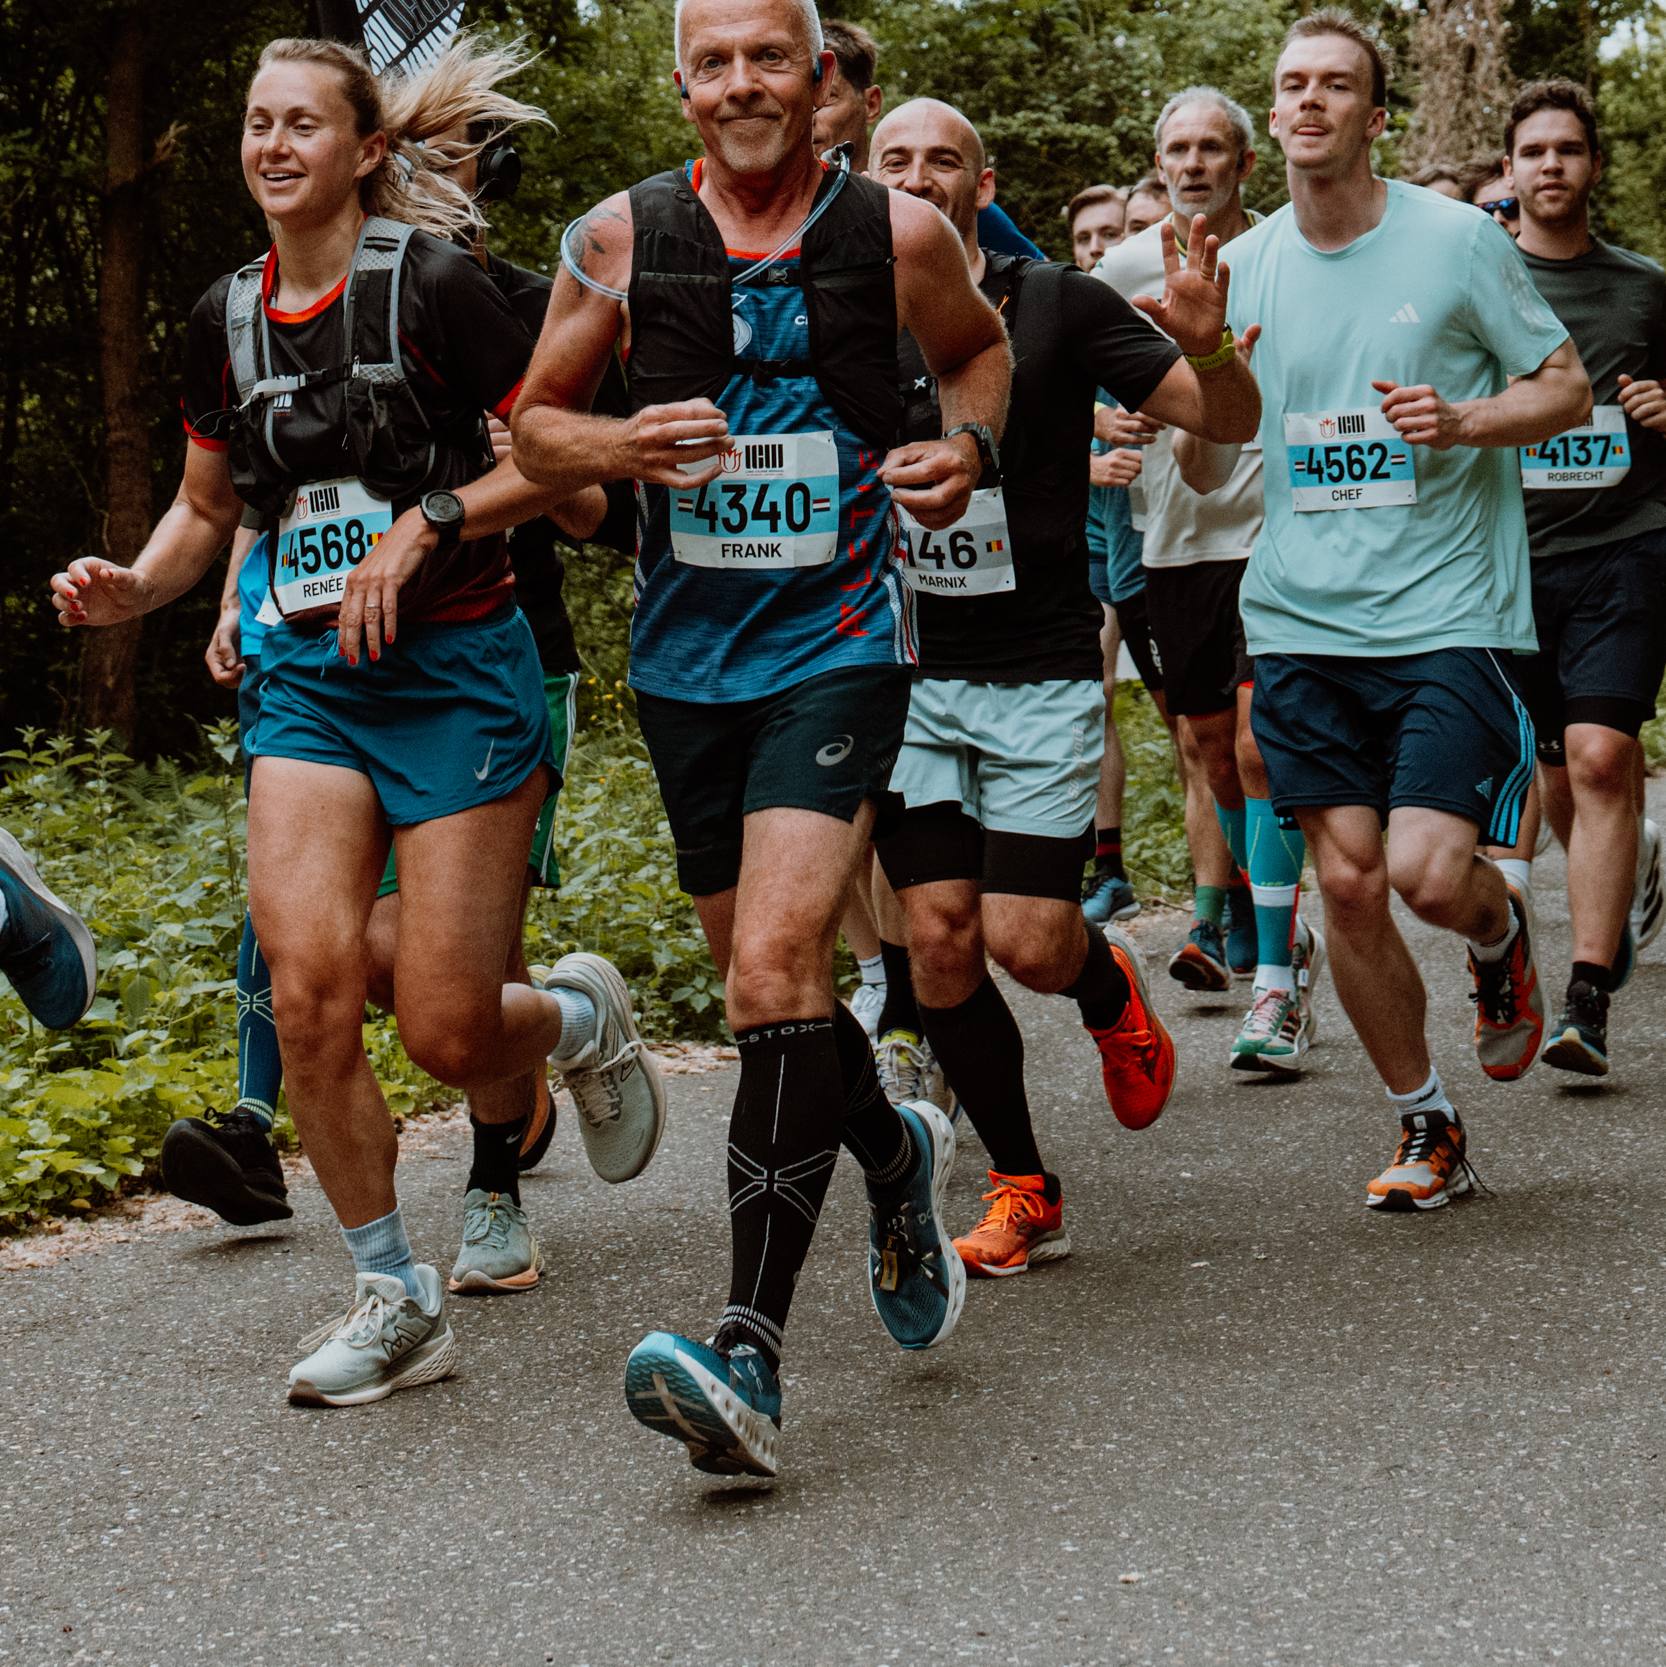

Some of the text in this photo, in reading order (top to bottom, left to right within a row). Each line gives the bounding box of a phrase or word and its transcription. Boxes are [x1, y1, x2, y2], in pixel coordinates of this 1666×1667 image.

[1538, 435, 1611, 467] 4137
[1307, 442, 1391, 484] 4562
[1548, 471, 1604, 481] ROBRECHT
[1331, 488, 1363, 501] CHEF
[695, 482, 810, 533] 4340
[288, 519, 366, 577] 4568
[721, 543, 782, 558] FRANK
[303, 575, 344, 598] RENÉE
[918, 574, 967, 588] MARNIX
[748, 1024, 815, 1043] STOX
